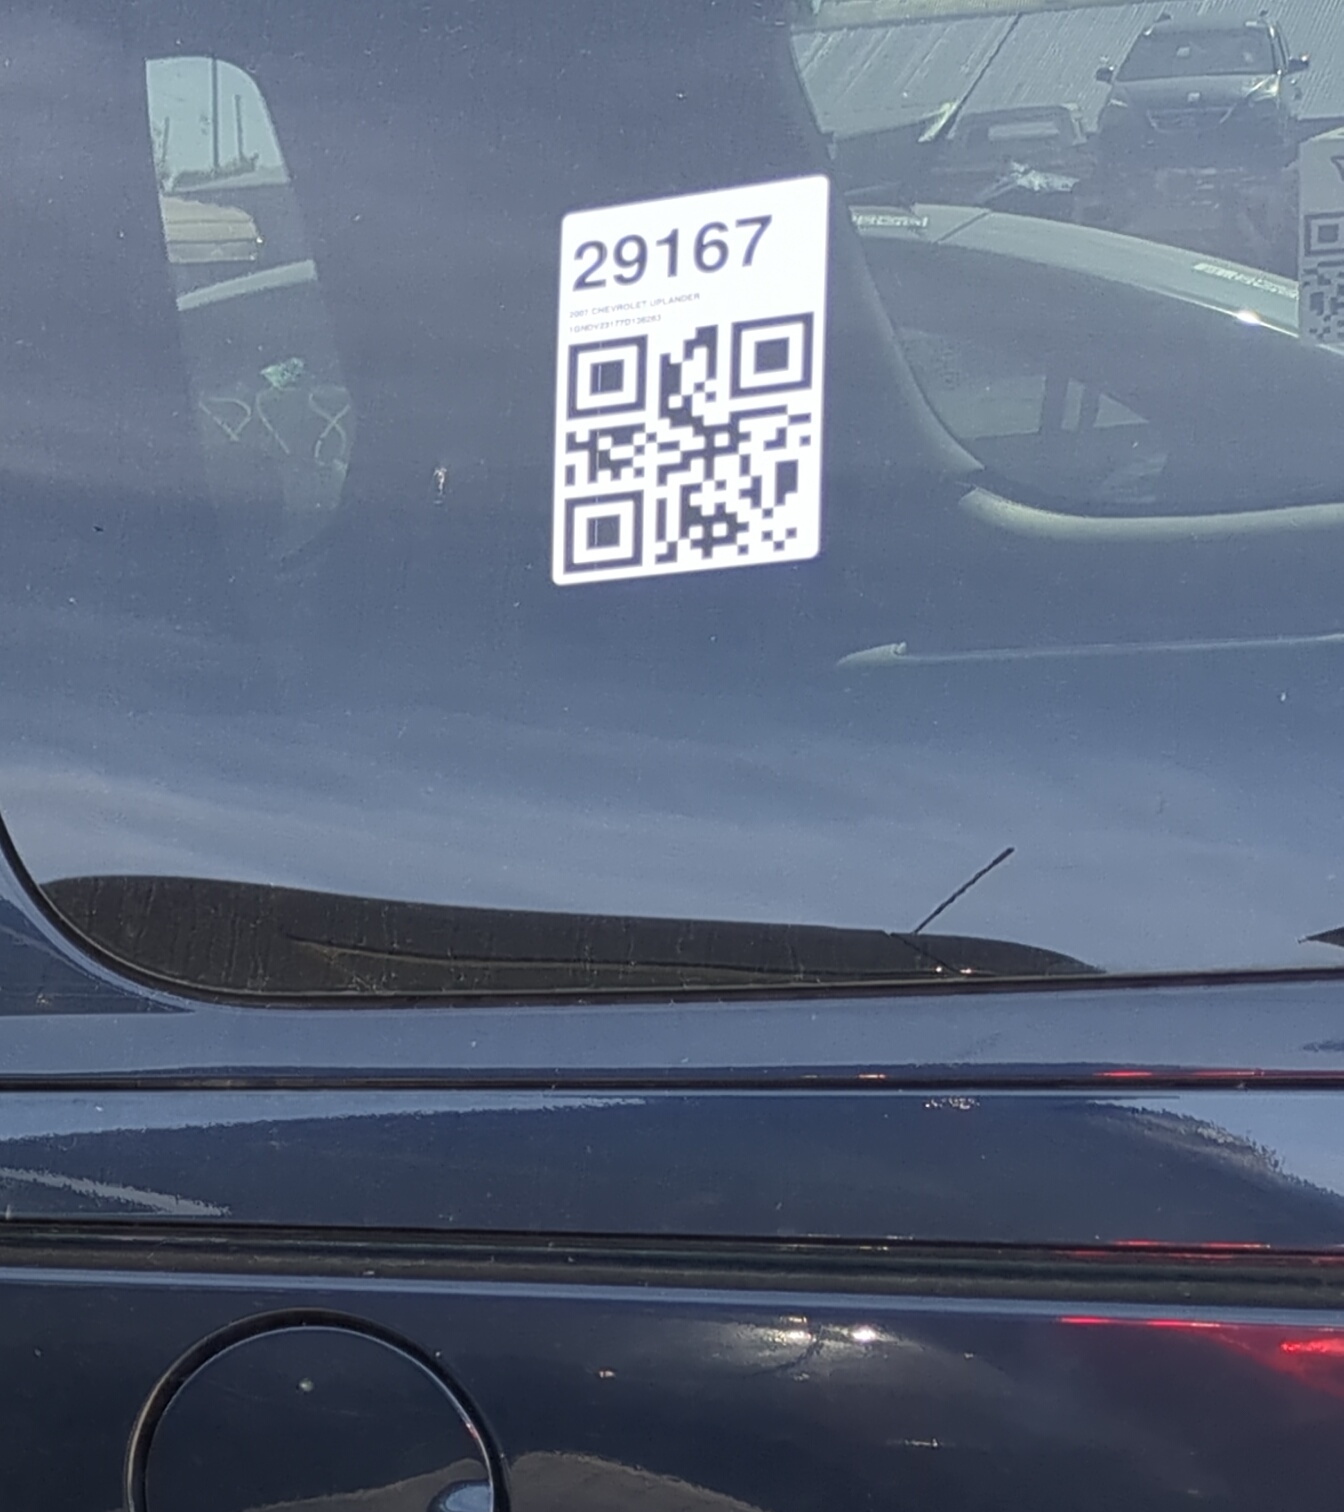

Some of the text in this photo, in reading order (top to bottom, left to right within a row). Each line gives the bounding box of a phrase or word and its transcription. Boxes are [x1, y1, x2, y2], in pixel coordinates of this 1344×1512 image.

[572, 213, 773, 292] 29167
[569, 292, 701, 319] 2007 CHEVROLET UPLANDER
